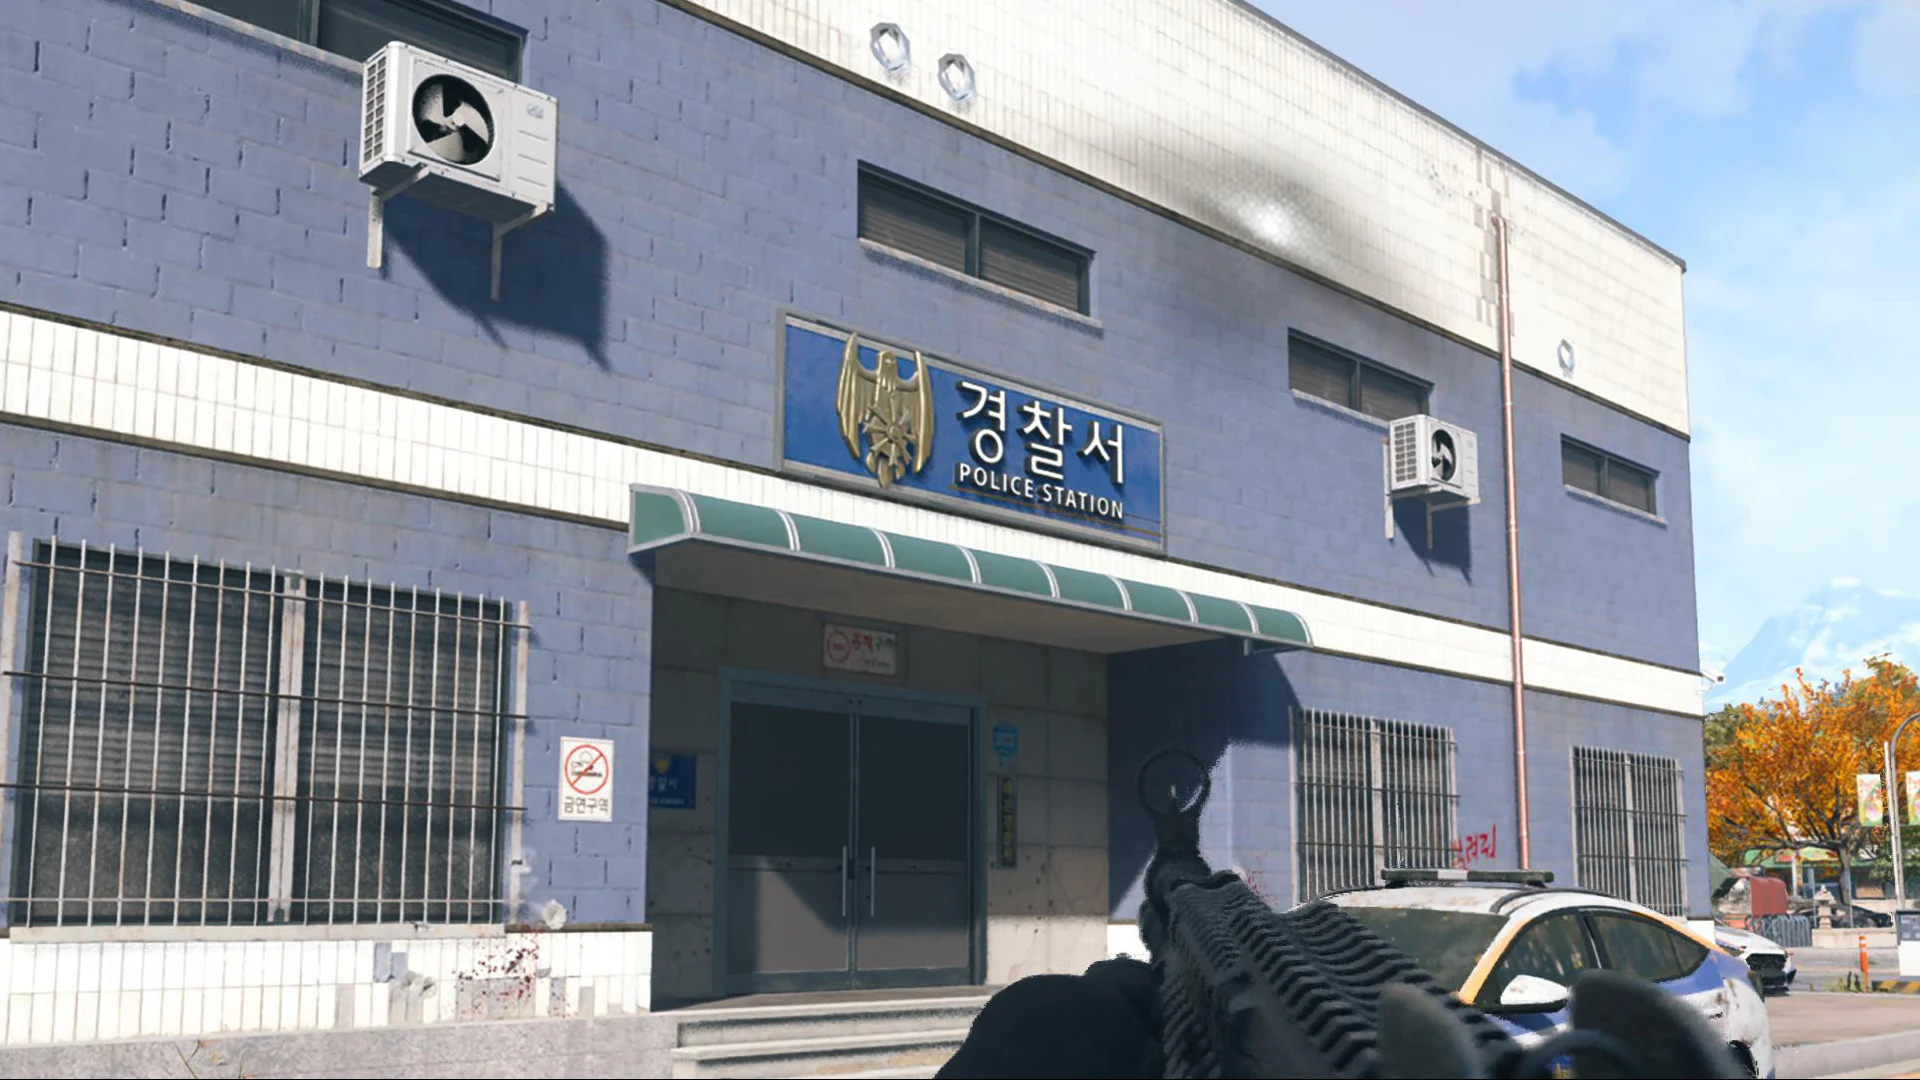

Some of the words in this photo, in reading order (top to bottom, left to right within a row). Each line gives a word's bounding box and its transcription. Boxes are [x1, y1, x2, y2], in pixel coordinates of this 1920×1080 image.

[961, 381, 1123, 484] 경찰서
[959, 463, 1034, 498] POLICE
[1043, 484, 1123, 519] STATION
[564, 796, 608, 814] 금연구역
